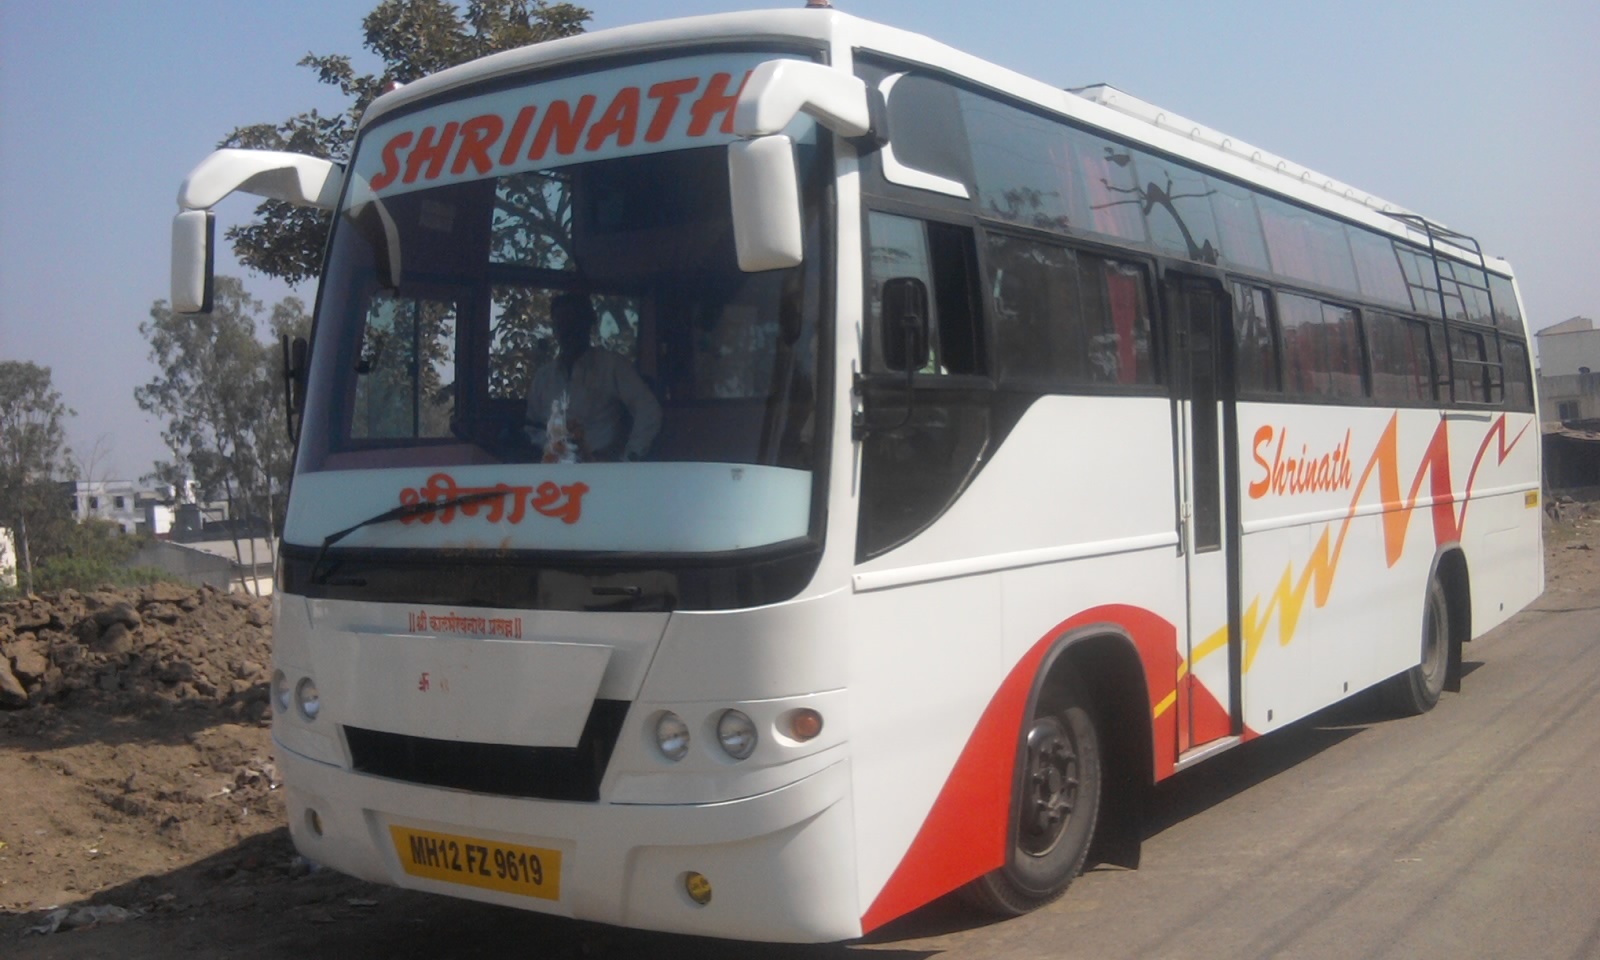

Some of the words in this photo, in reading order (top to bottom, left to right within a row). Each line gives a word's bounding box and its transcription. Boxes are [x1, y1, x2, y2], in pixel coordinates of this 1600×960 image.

[370, 70, 753, 191] SHRINATH
[1248, 425, 1352, 499] Shrinath
[399, 472, 590, 525] श्रीनाथ
[409, 835, 462, 872] MH12
[465, 844, 491, 877] FZ
[494, 848, 543, 885] 9619
